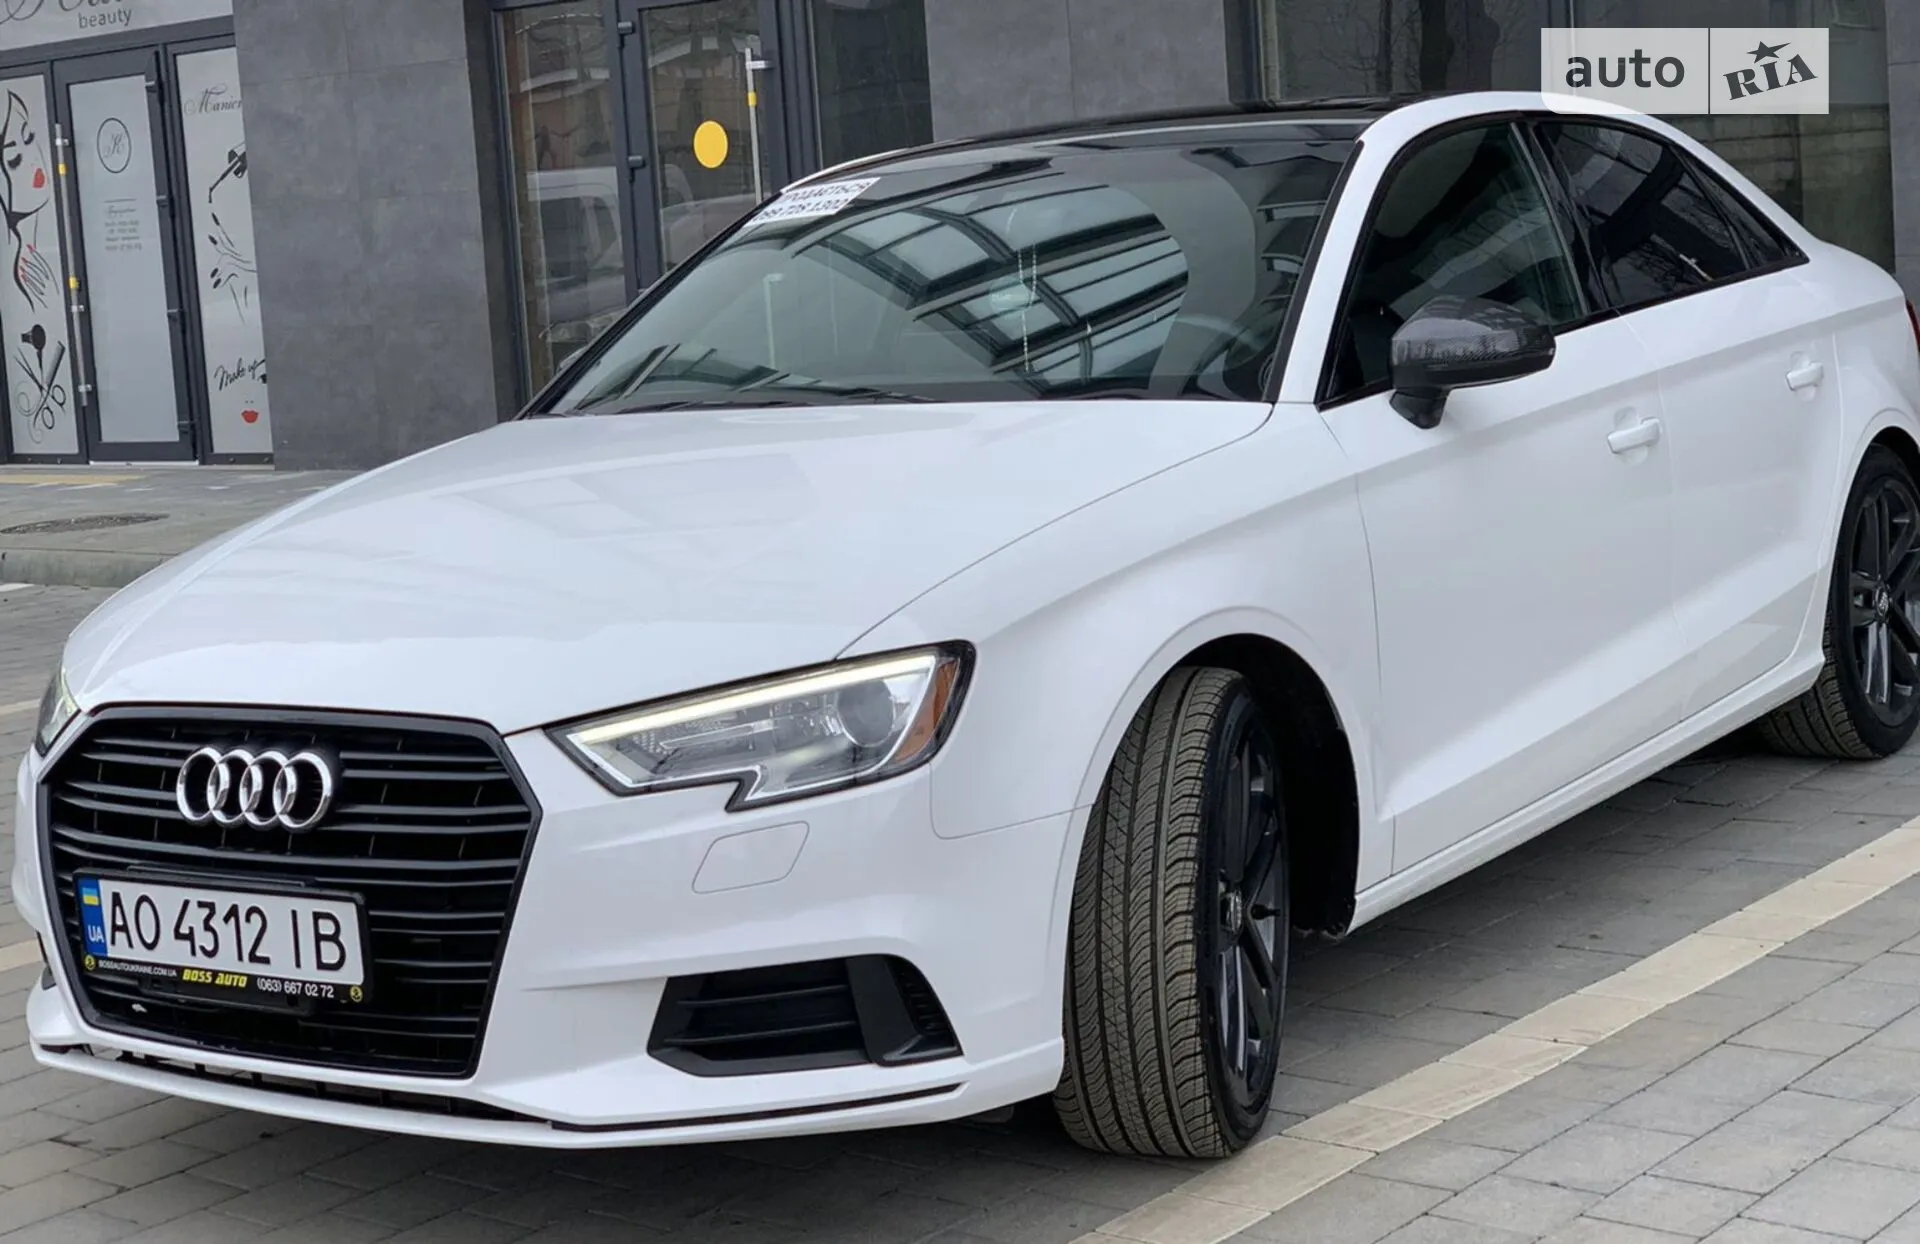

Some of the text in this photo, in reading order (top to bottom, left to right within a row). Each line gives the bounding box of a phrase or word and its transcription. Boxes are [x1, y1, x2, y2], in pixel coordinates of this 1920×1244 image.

[78, 9, 132, 29] beauty
[87, 925, 105, 943] UA
[110, 891, 160, 951] AO
[173, 898, 271, 965] 4312
[182, 968, 213, 984] BOSS
[215, 973, 248, 988] AUTO
[257, 978, 282, 993] (063)
[284, 980, 302, 995] 667
[304, 983, 319, 997] 02
[321, 985, 335, 999] 72
